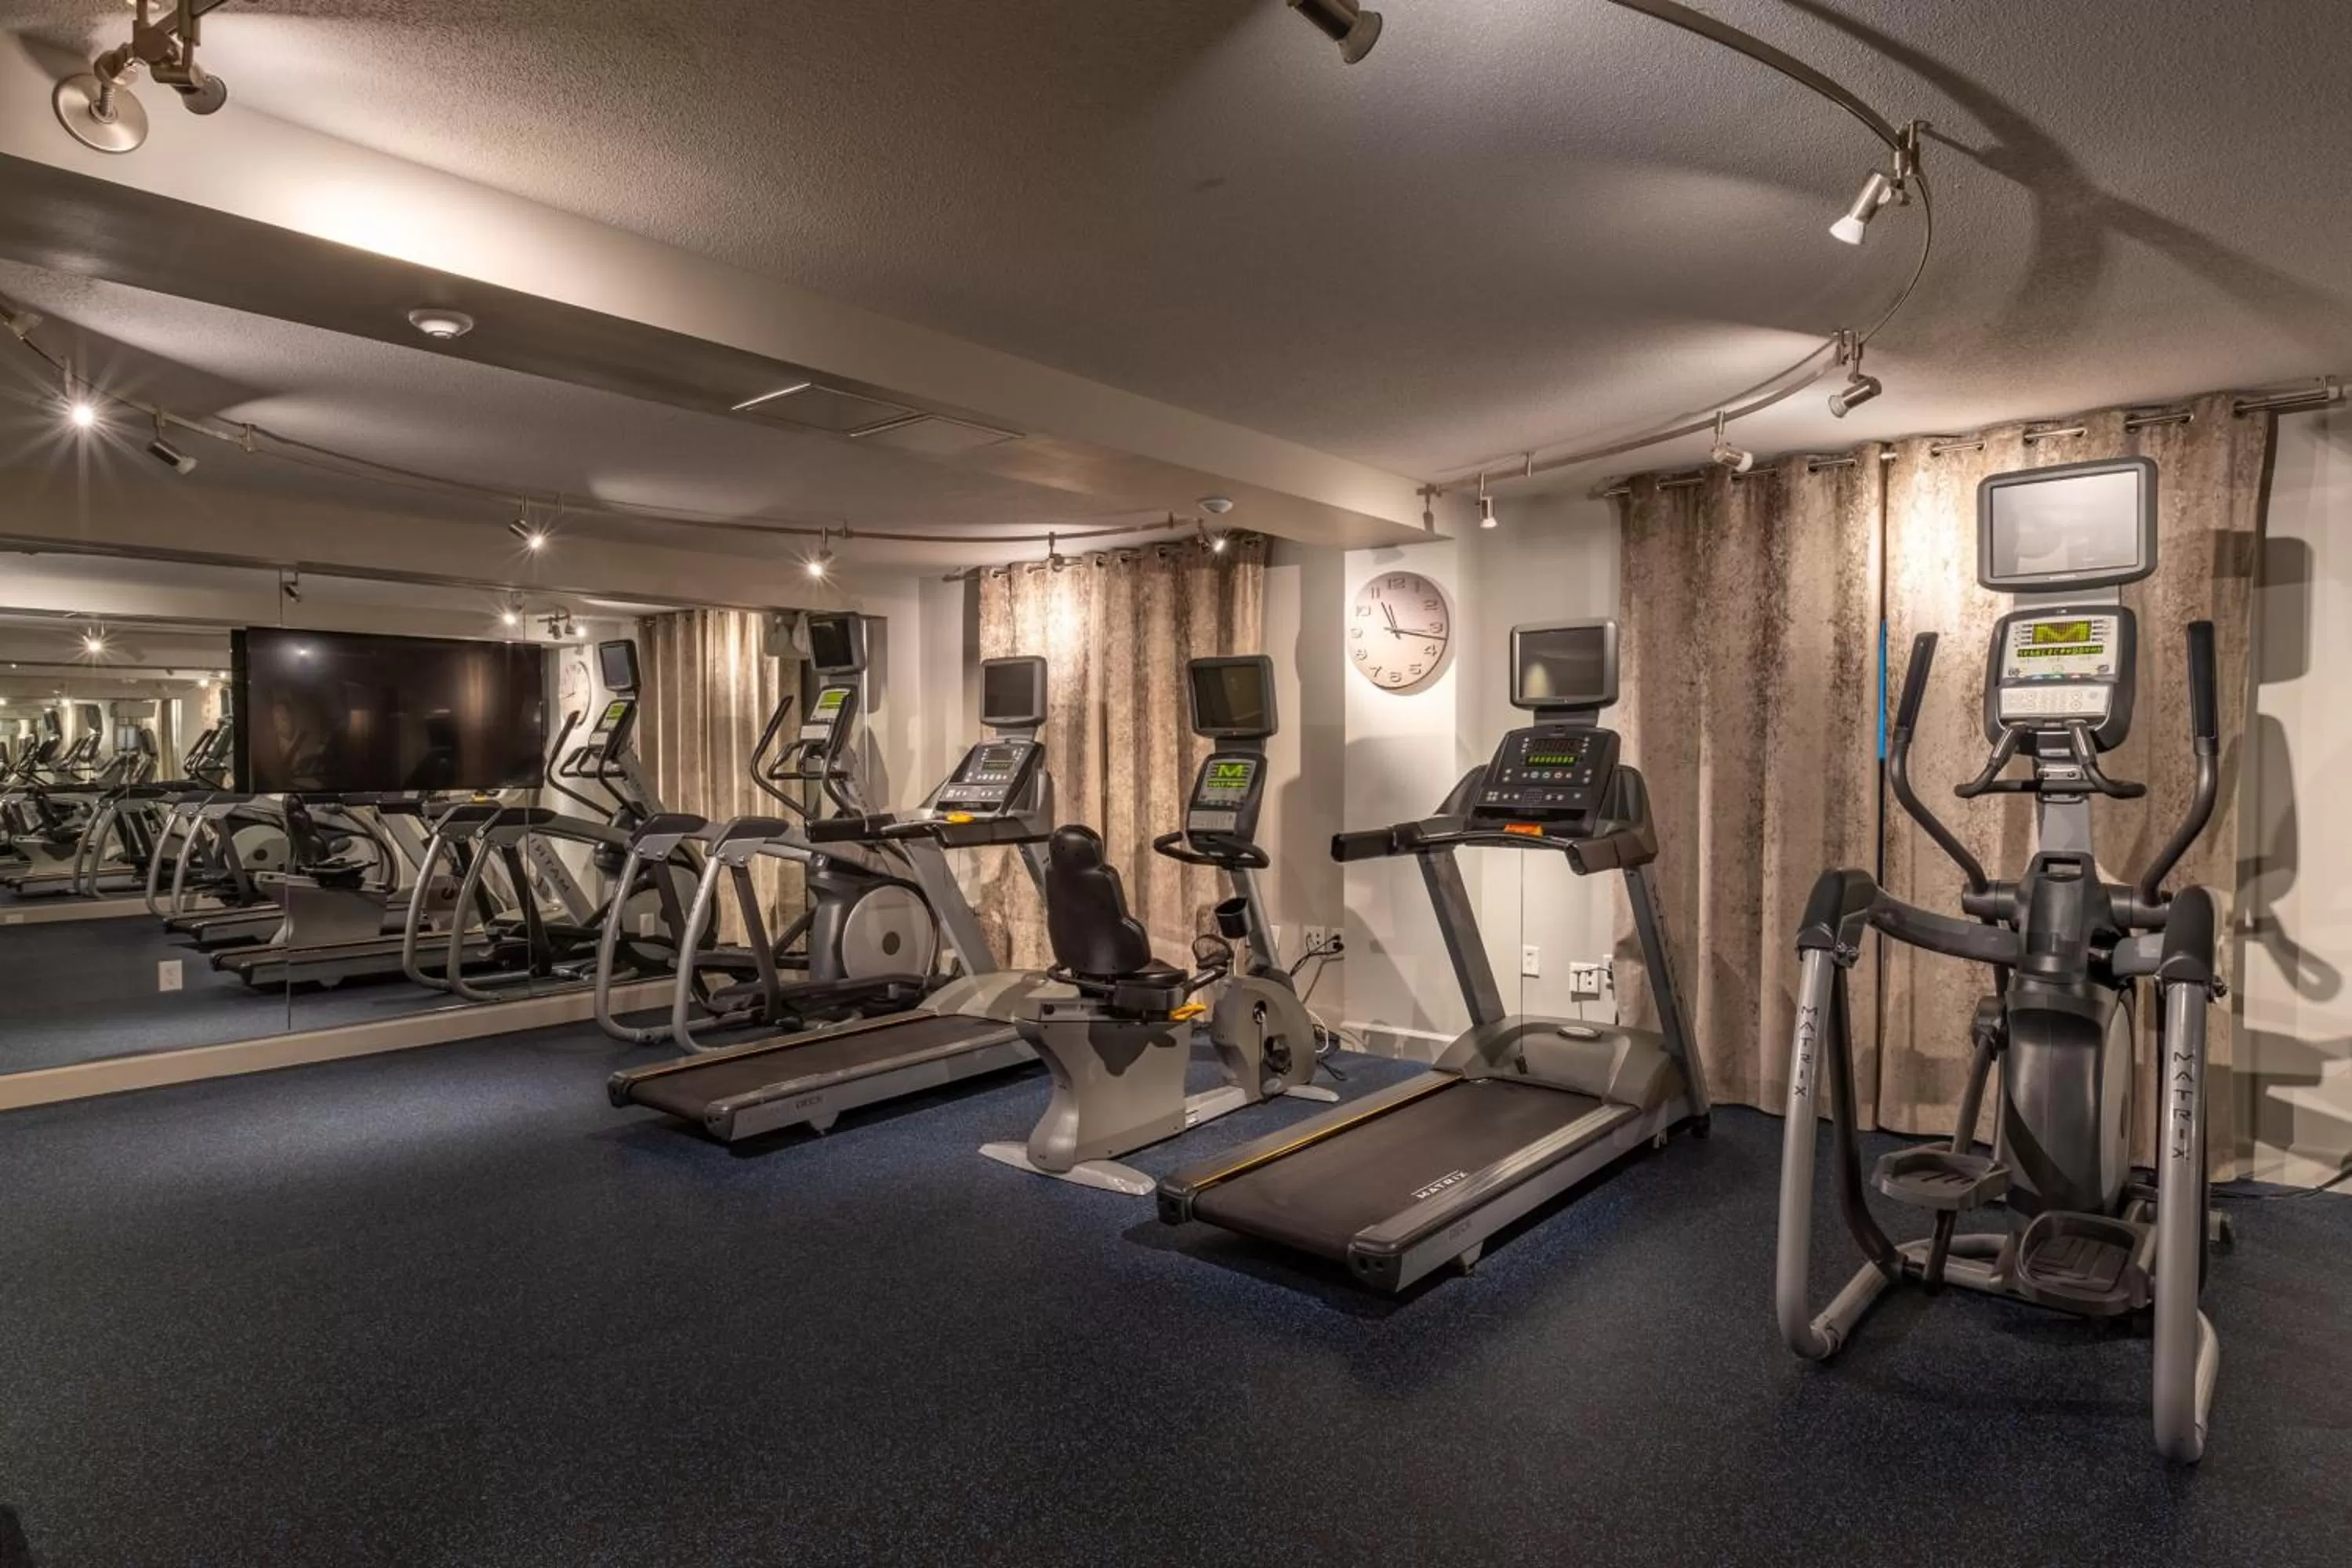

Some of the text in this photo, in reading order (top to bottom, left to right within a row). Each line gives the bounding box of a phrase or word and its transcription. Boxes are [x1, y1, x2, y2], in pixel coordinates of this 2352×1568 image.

[1387, 577, 1406, 590] 12
[1370, 586, 1381, 600] 11
[1424, 599, 1439, 611] 2
[1429, 622, 1443, 634] 3
[1424, 644, 1437, 657] 4
[1370, 665, 1383, 678] 7
[1409, 663, 1421, 676] 5
[1218, 764, 1243, 777] M
[1793, 1005, 1819, 1098] MATRIX
[2171, 1051, 2196, 1161] MATRIX
[1414, 1172, 1468, 1199] MATRIX
